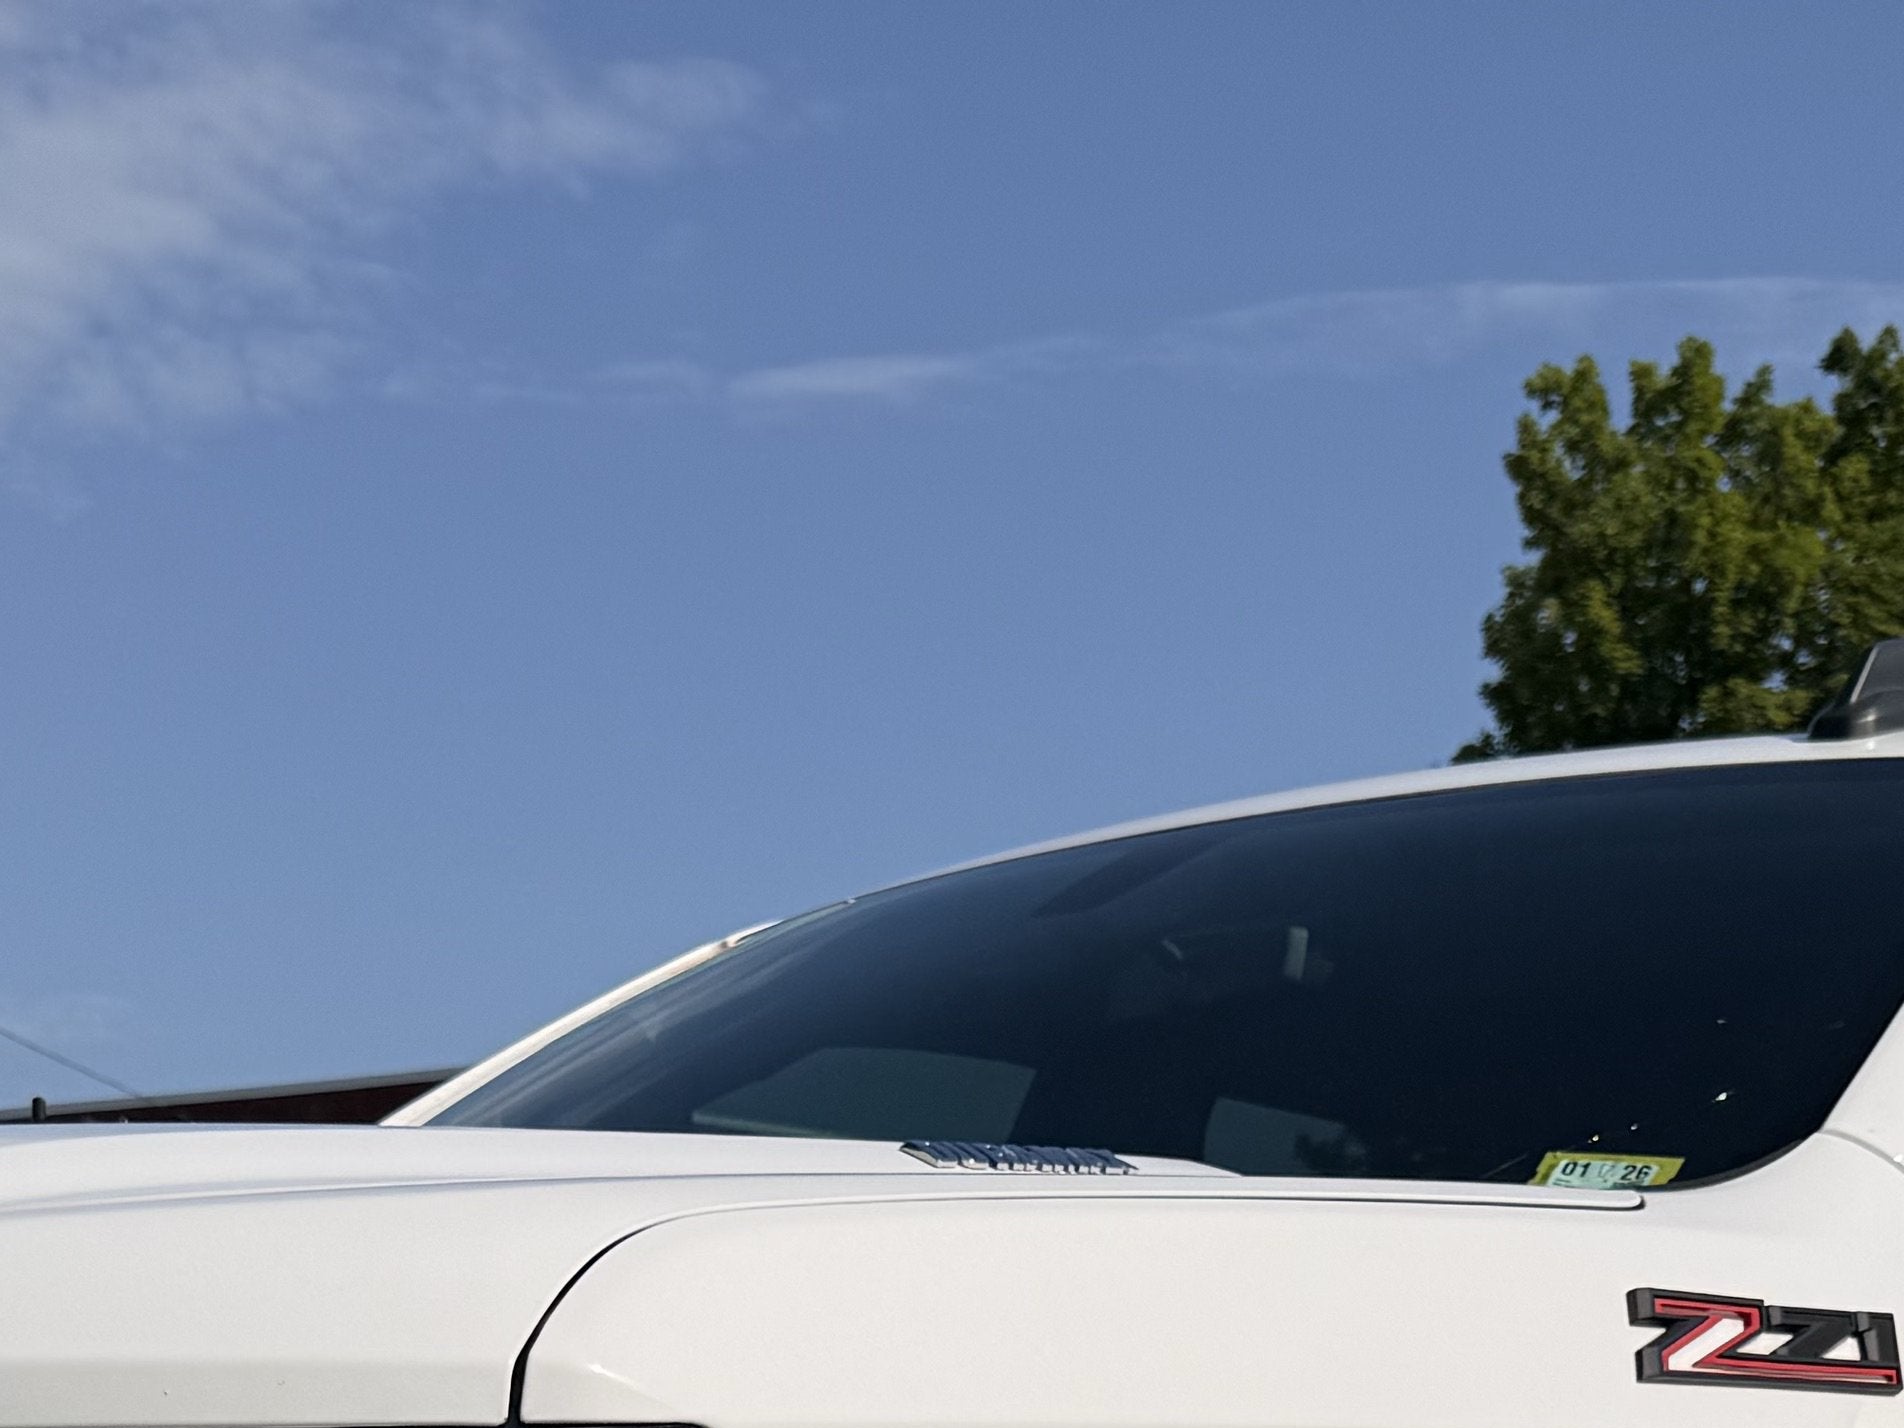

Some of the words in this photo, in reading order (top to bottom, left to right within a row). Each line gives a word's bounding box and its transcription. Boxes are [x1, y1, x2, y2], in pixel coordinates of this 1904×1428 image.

[1561, 1161, 1591, 1178] 01
[1620, 1164, 1652, 1182] 26
[1626, 1287, 1903, 1397] Z71
